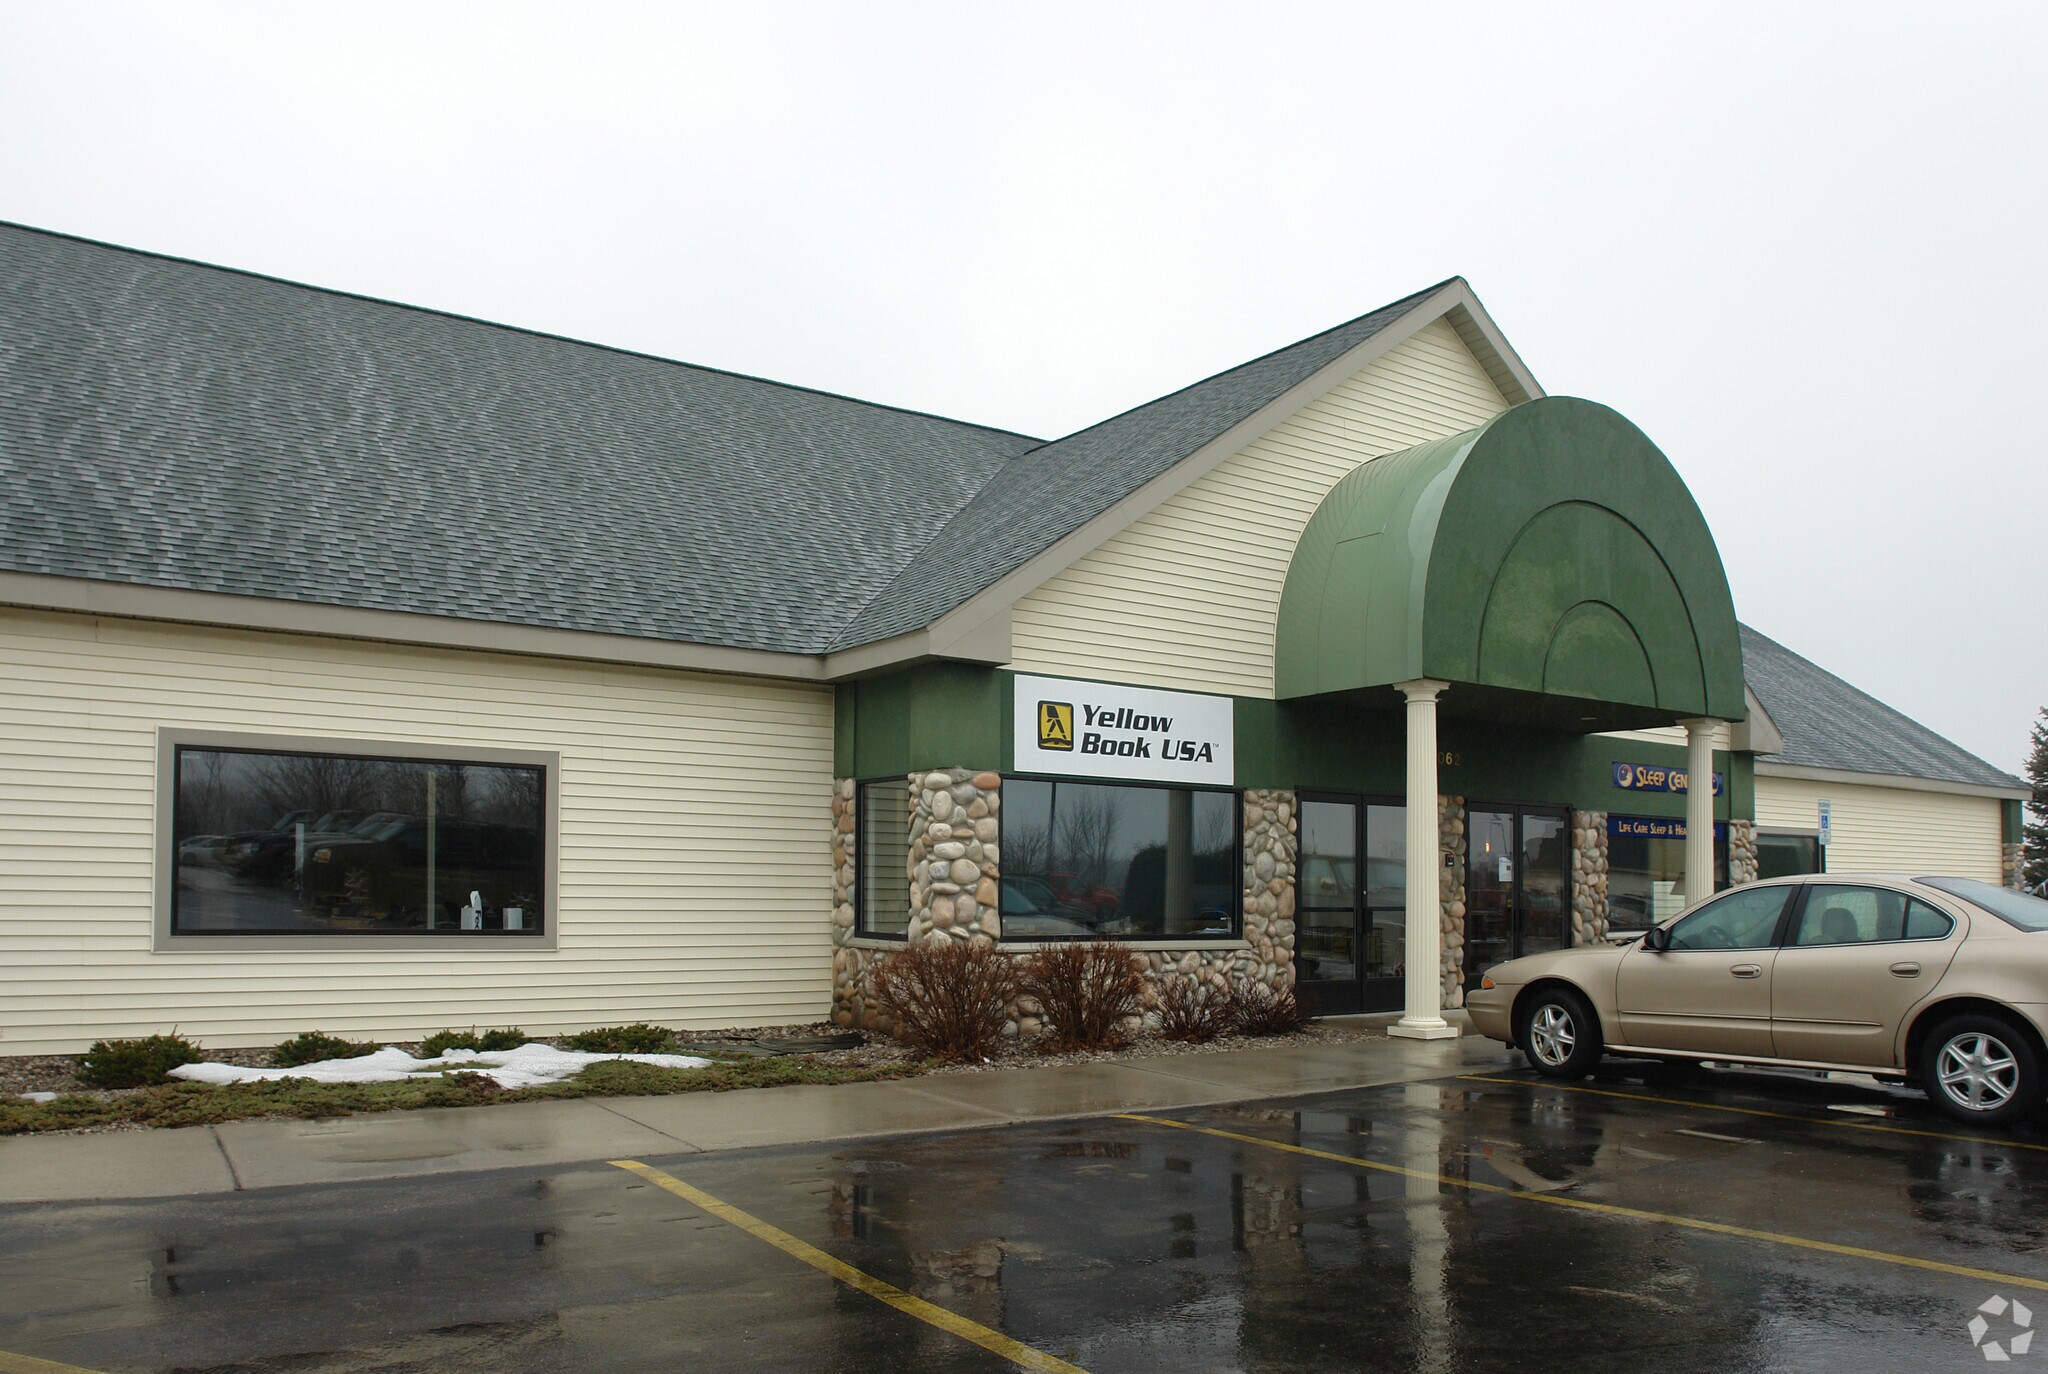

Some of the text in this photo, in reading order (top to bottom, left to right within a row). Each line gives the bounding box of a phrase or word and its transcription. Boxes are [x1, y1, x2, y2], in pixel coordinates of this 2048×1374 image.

[1083, 704, 1173, 733] Yellow
[1080, 732, 1152, 758] Book
[1161, 739, 1213, 763] USA
[1636, 767, 1689, 791] SLEEP CEN
[1619, 821, 1688, 835] LIFE CARE SLEEP & HEA
